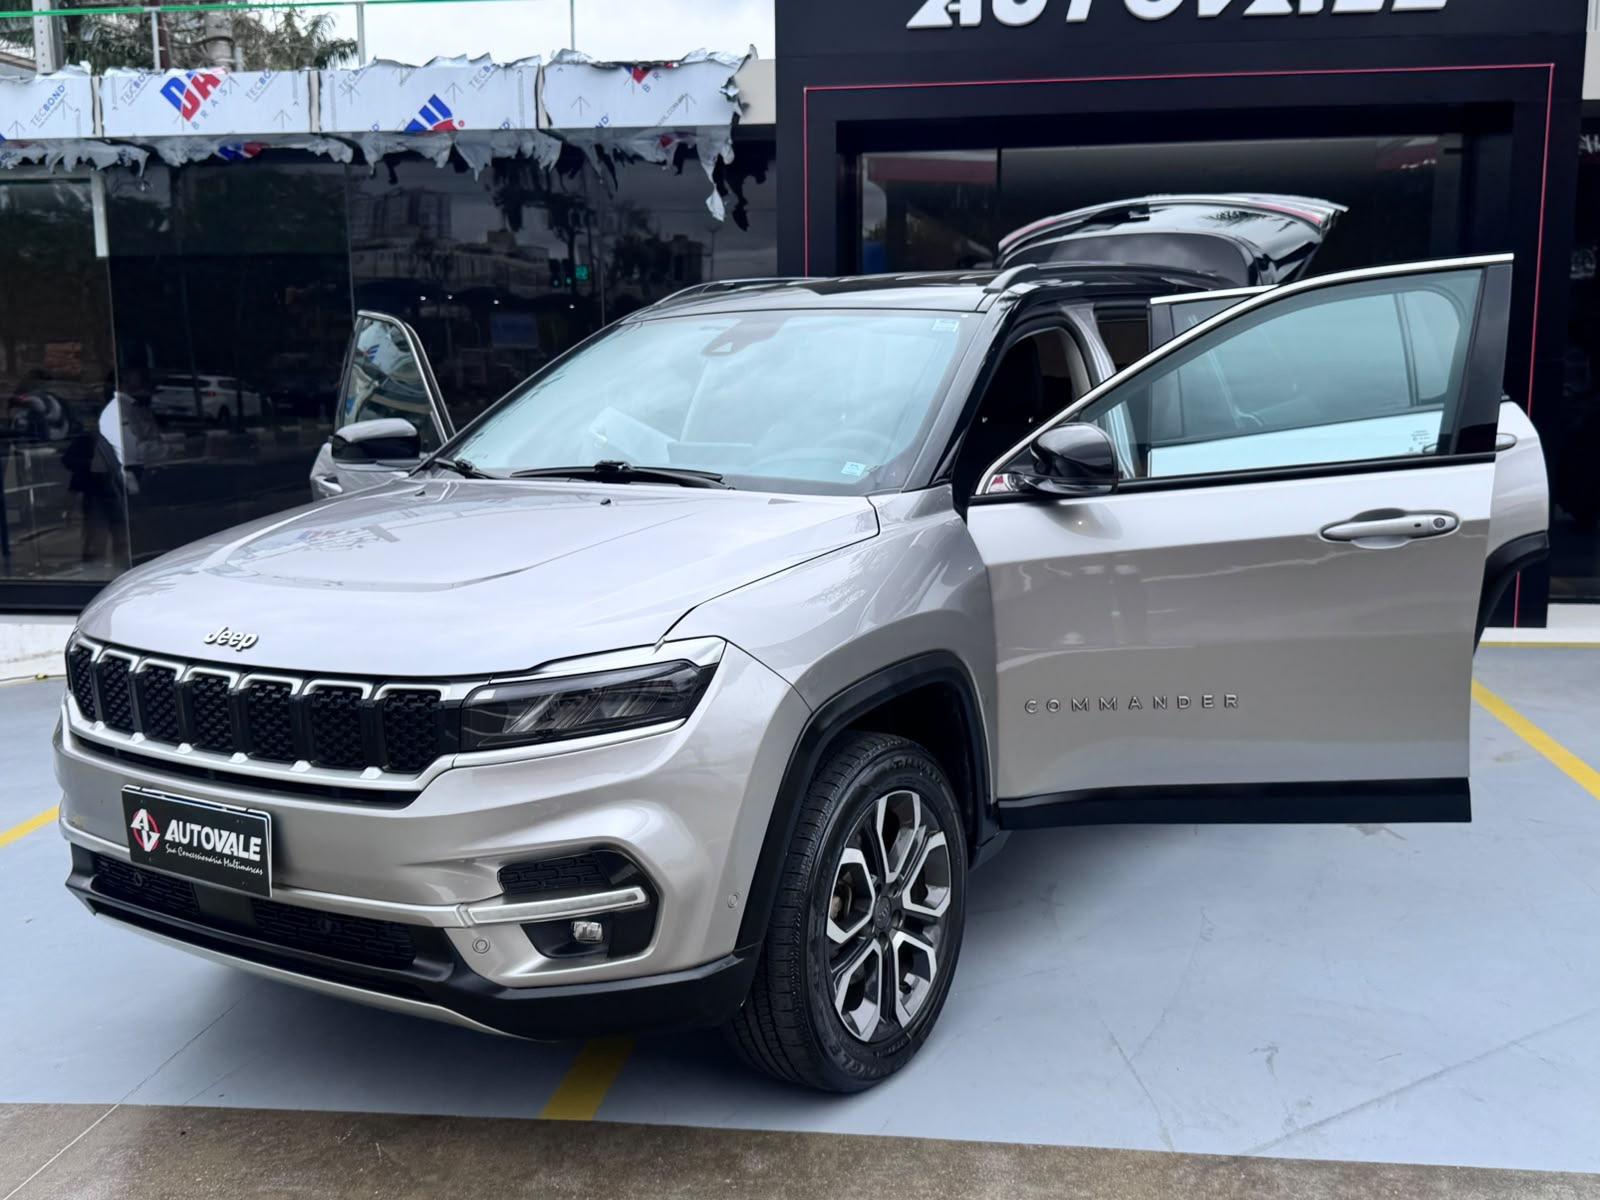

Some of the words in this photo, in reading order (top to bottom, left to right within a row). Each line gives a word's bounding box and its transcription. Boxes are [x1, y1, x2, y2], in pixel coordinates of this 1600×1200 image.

[31, 84, 66, 126] TECBOND
[203, 626, 259, 651] Jeep
[1024, 693, 1239, 714] COMMANDER
[164, 819, 262, 862] AUTOVALE
